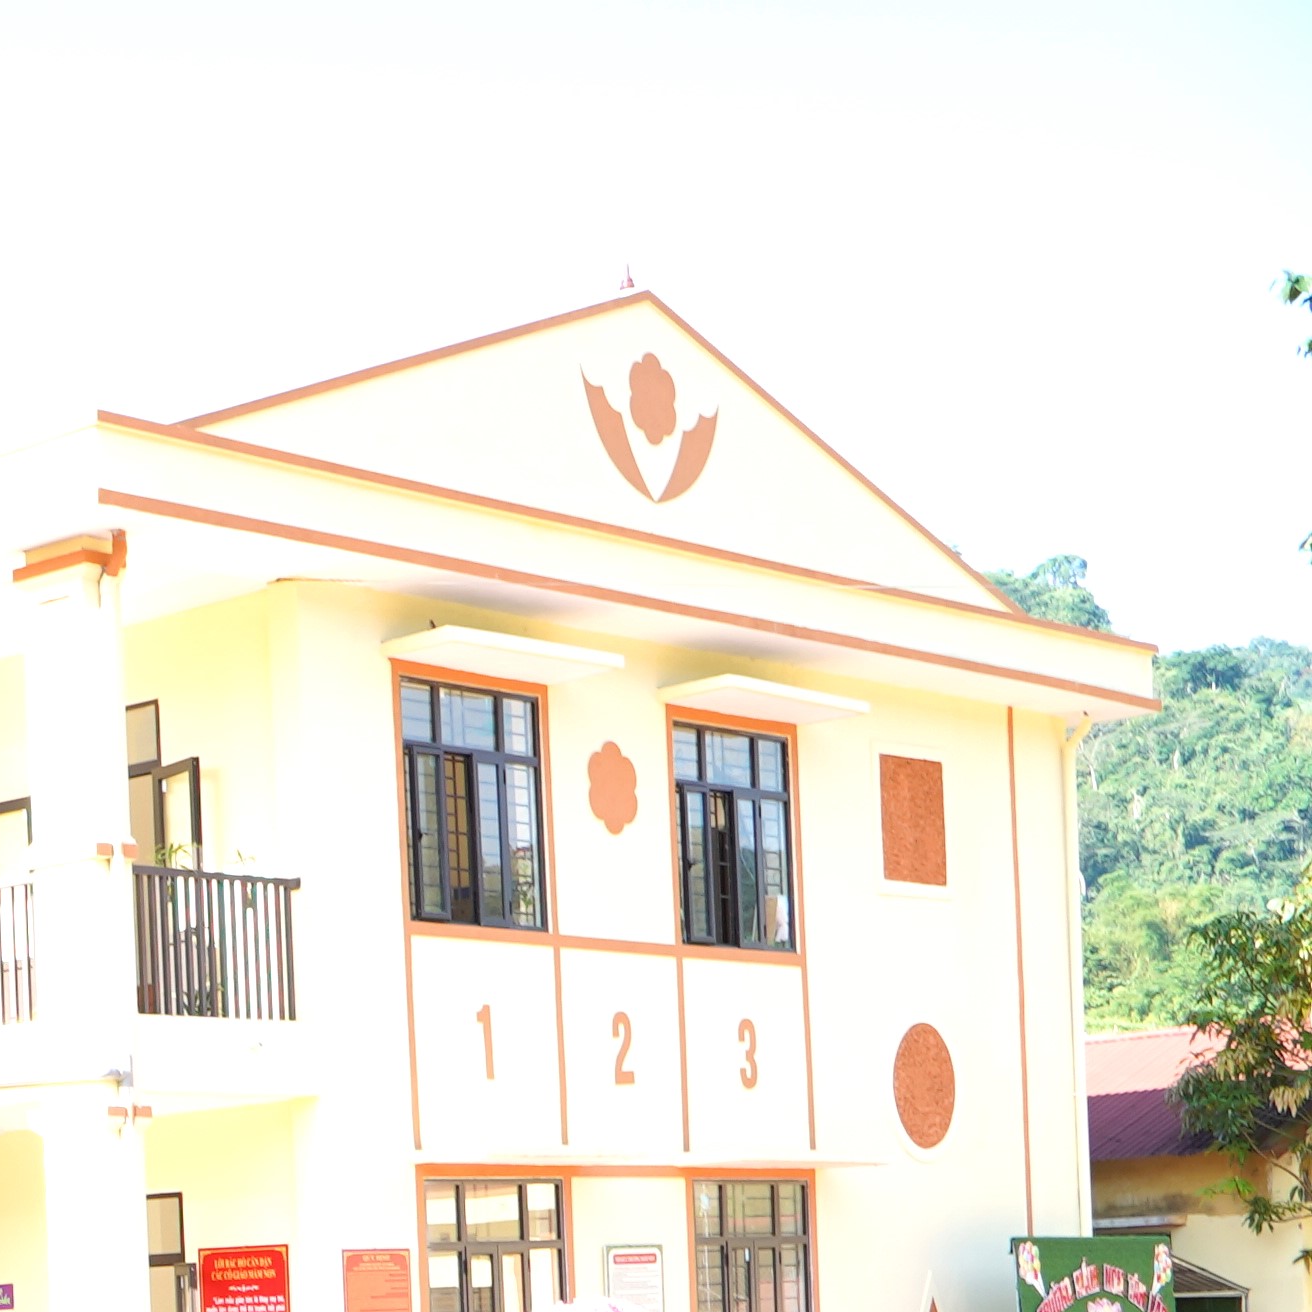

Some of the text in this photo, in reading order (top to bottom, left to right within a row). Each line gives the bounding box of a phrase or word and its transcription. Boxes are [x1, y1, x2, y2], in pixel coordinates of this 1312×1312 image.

[476, 1004, 495, 1081] 1
[612, 1011, 635, 1086] 2
[738, 1018, 758, 1090] 3
